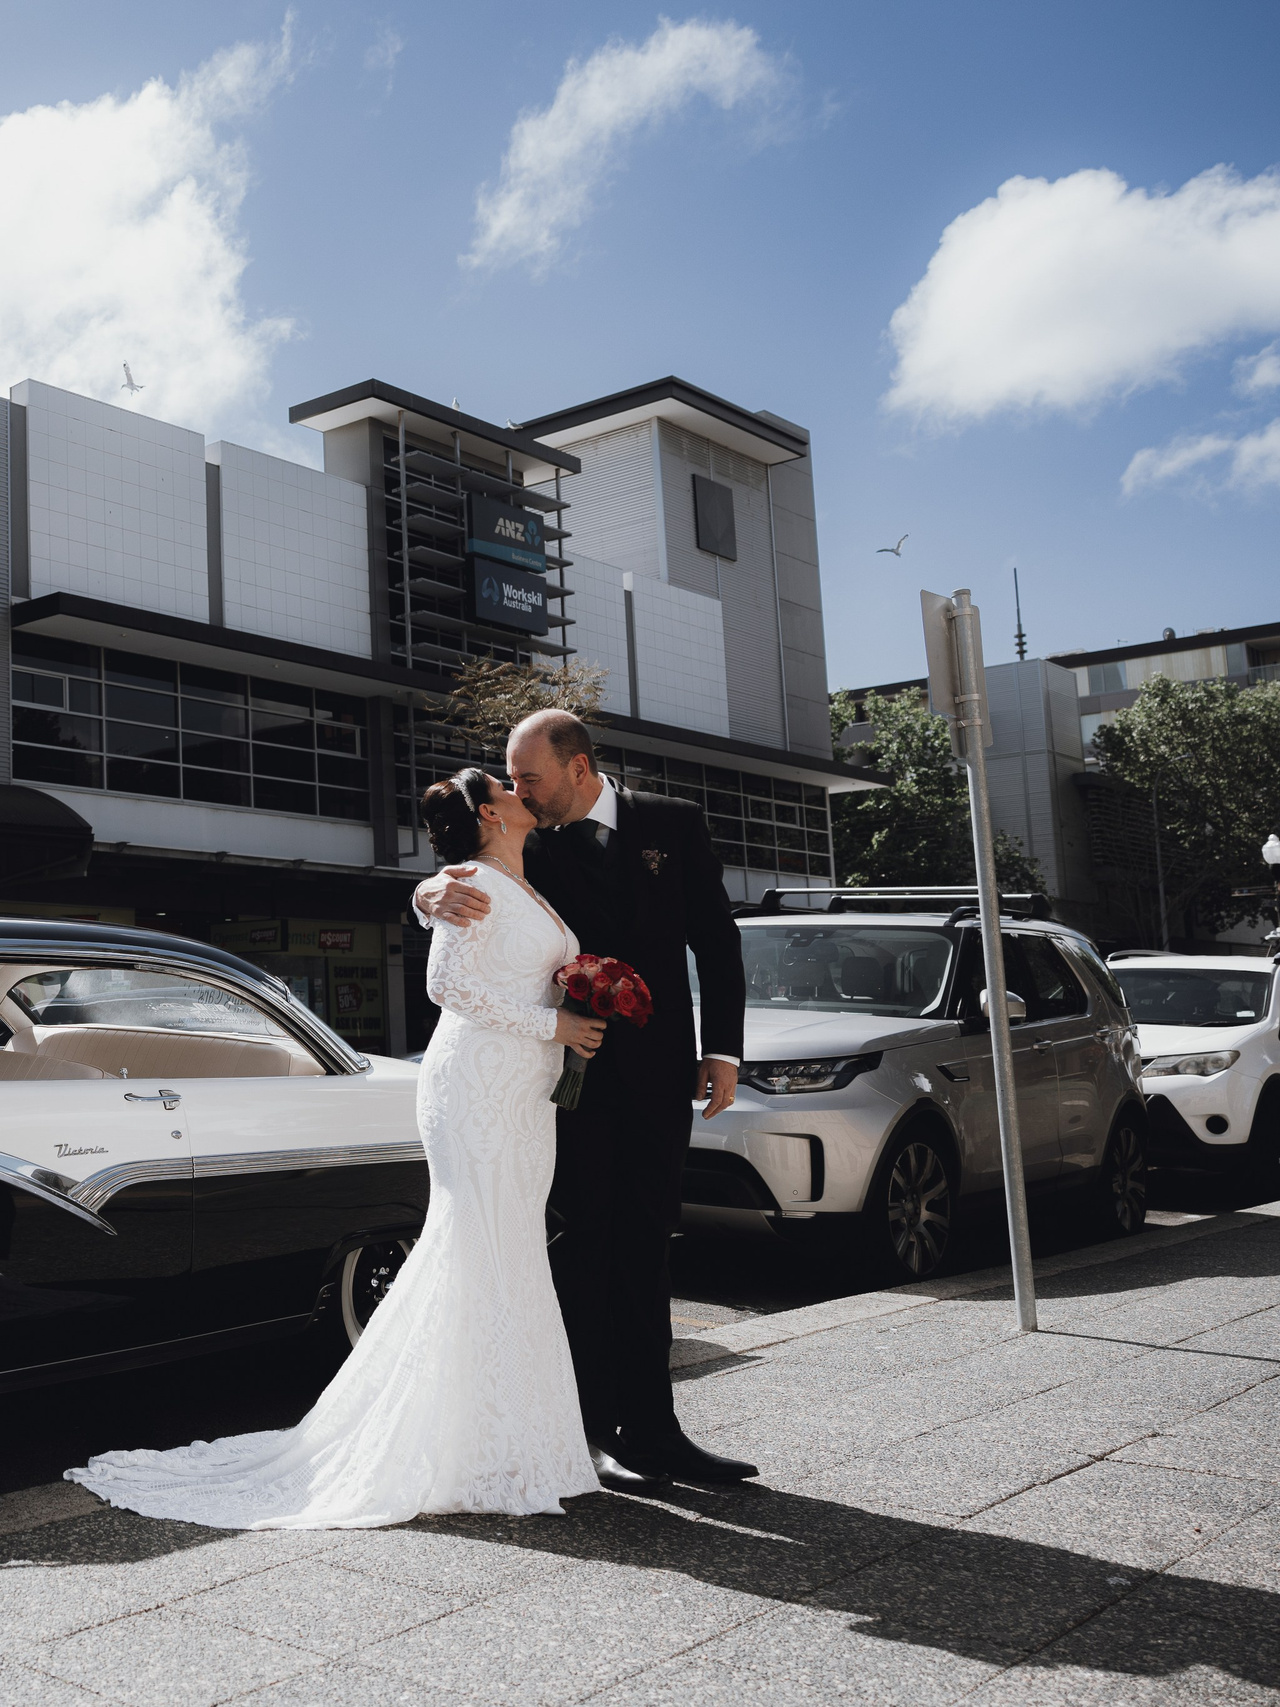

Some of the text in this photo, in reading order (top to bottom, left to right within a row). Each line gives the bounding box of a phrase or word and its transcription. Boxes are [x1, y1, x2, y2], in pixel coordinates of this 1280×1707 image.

[494, 517, 526, 542] ANZ
[511, 552, 528, 564] Business
[502, 583, 543, 607] Workskil
[503, 597, 533, 613] Australia
[338, 994, 357, 1008] 50%
[53, 1143, 109, 1158] Victoria
